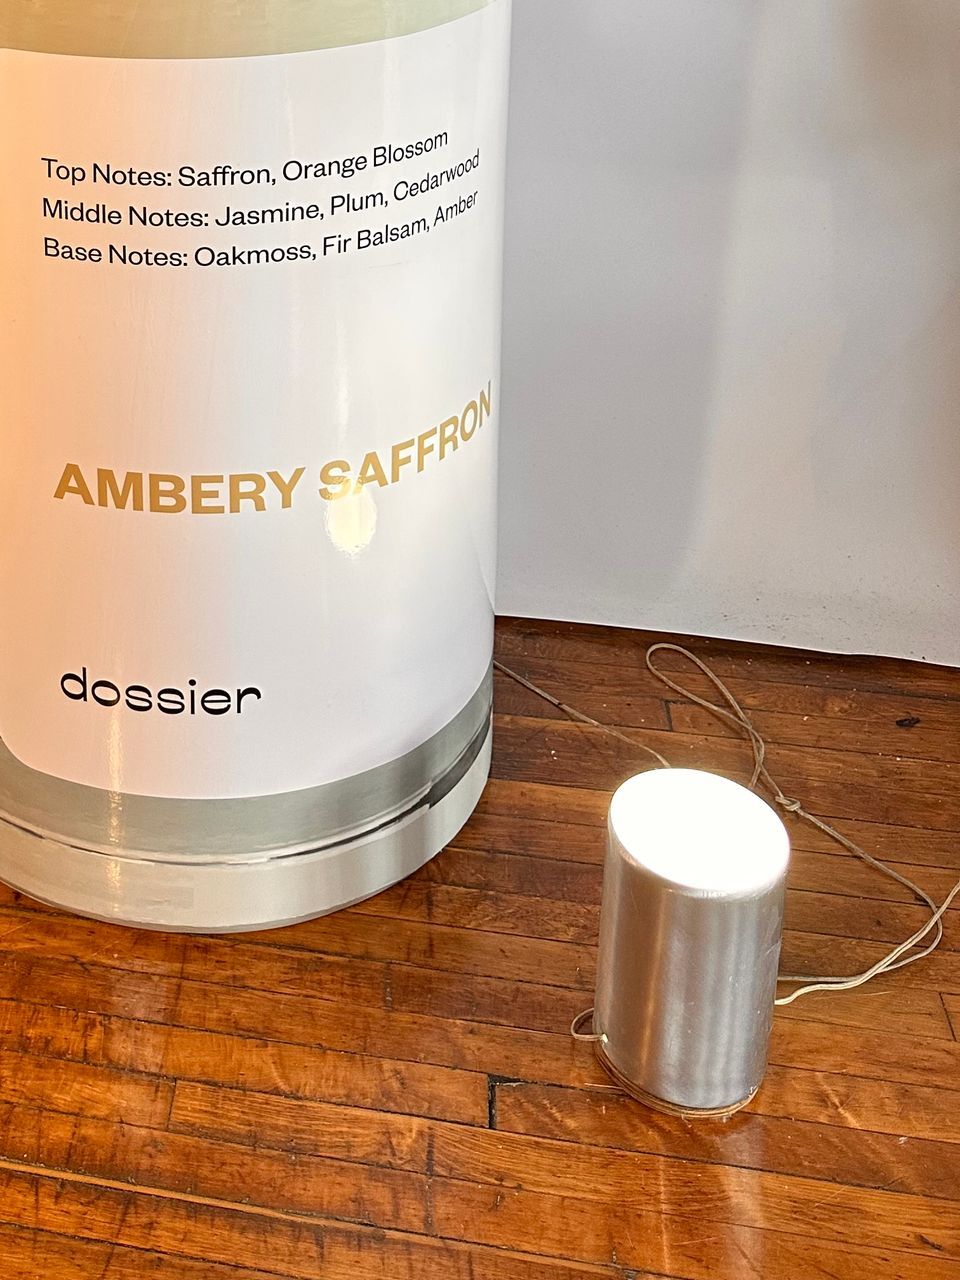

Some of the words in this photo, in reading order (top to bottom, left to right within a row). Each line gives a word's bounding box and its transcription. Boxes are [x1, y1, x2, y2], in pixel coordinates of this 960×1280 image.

[40, 157, 86, 186] Top
[92, 162, 172, 187] Notes:
[178, 165, 276, 187] Saffron,
[282, 156, 368, 180] Orange
[373, 131, 448, 168] Blossom
[42, 197, 122, 225] Middle
[128, 205, 209, 228] Notes:
[214, 202, 324, 228] Jasmine,
[330, 192, 389, 216] Plum,
[393, 148, 480, 202] Cedarwood
[44, 236, 103, 264] Base
[108, 244, 188, 267] Notes:
[194, 244, 317, 267] Oakmoss,
[323, 234, 353, 256] Fir
[357, 219, 430, 251] Balsam,
[433, 189, 478, 227] Amber
[54, 463, 306, 515] AMBERY
[318, 379, 491, 501] SAFFRON
[60, 666, 262, 716] dossier
